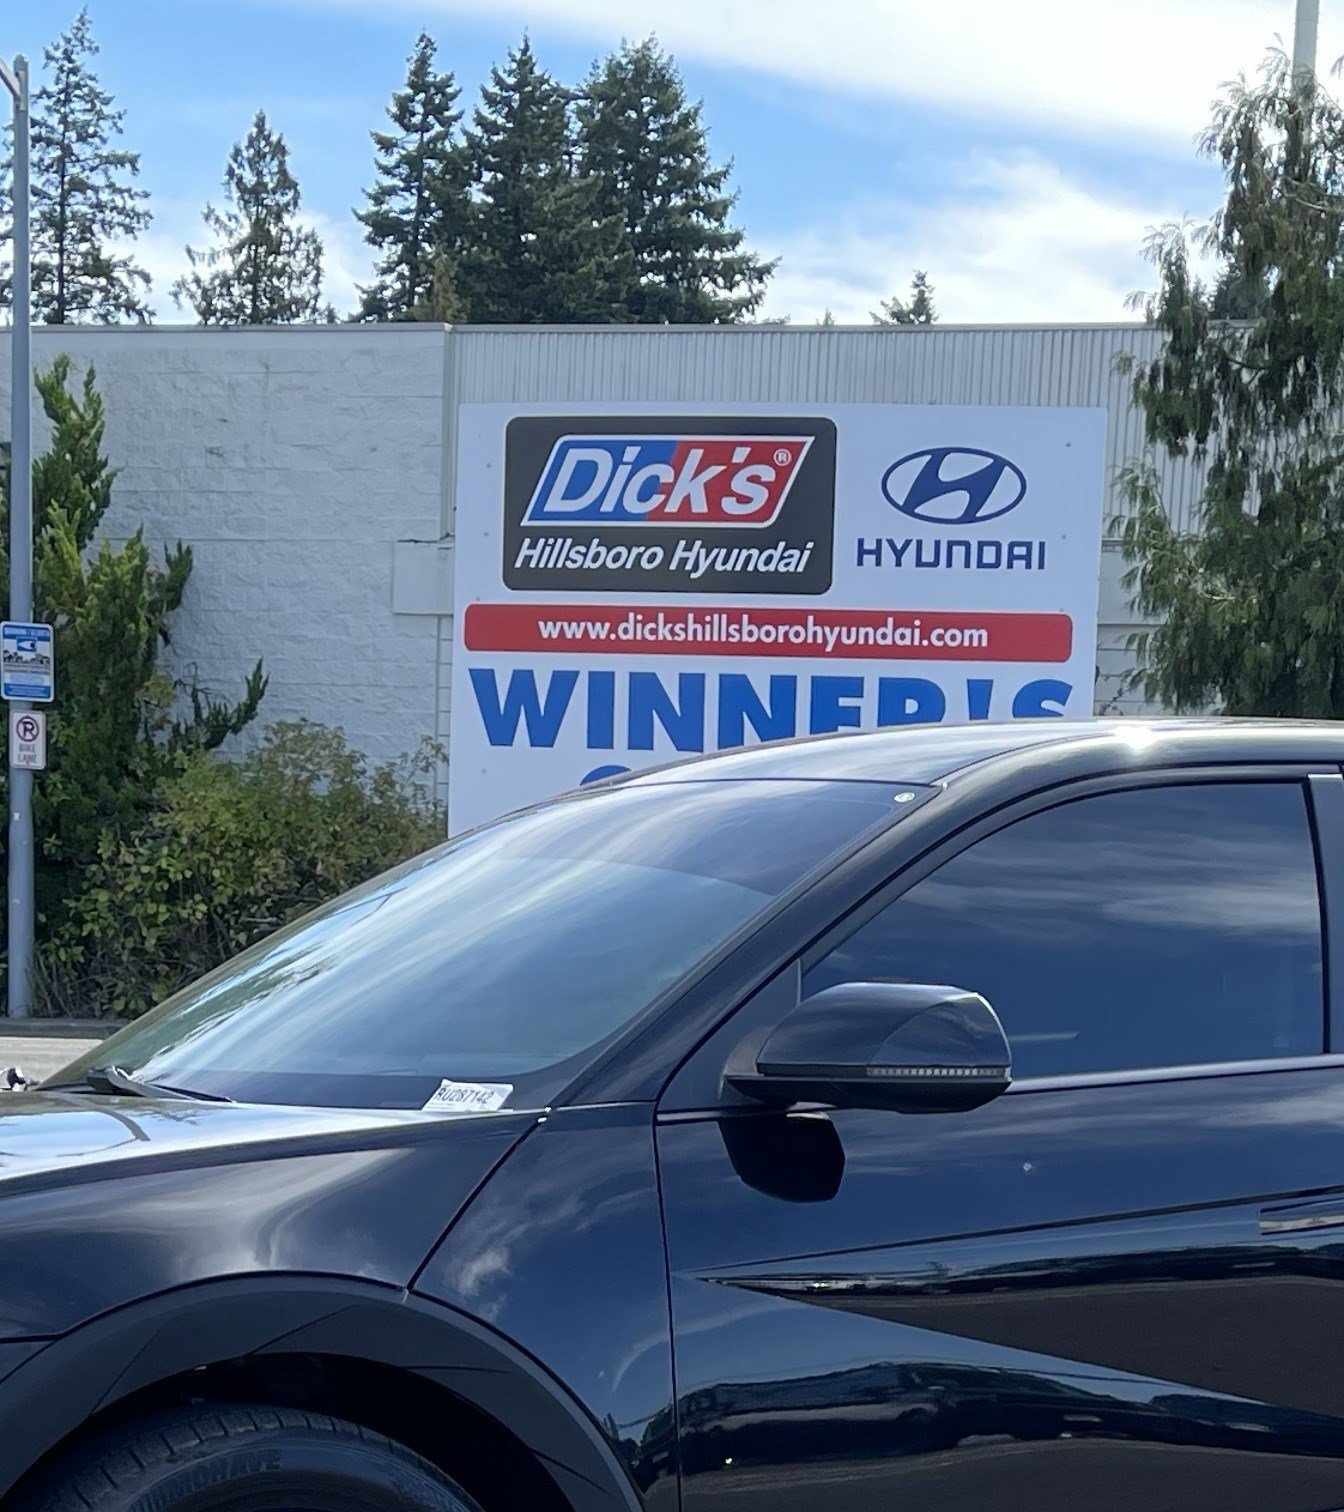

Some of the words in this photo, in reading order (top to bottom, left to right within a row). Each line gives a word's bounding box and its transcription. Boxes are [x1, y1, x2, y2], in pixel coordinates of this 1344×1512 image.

[542, 446, 777, 518] Dick's
[513, 537, 664, 570] Hillsboro
[668, 540, 814, 579] Hyundai
[857, 538, 1046, 571] HYUNDAI
[539, 612, 988, 652] www.dickshillsborohyundai.com
